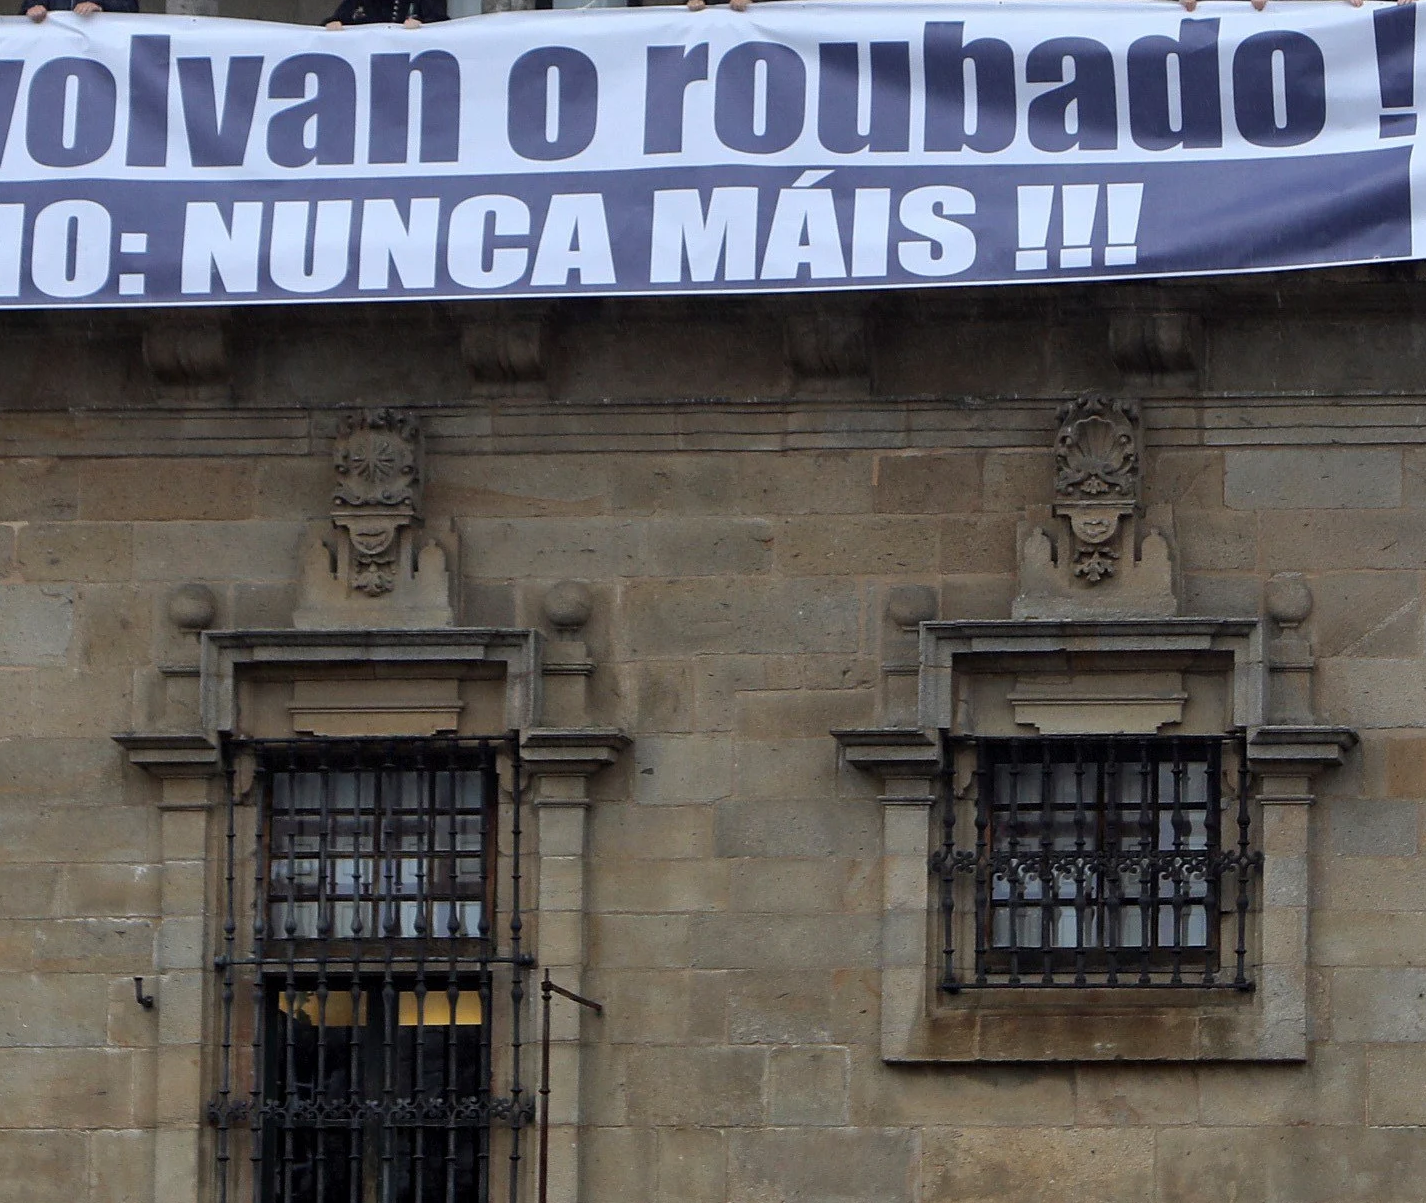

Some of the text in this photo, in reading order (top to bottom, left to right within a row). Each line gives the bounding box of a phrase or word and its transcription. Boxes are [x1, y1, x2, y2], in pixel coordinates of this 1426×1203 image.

[506, 45, 599, 162] o
[643, 18, 1326, 156] roubado
[1373, 3, 1419, 139] !
[181, 194, 618, 295] NUNCA
[649, 170, 976, 284] MÁIS
[1014, 182, 1146, 272] !!!
